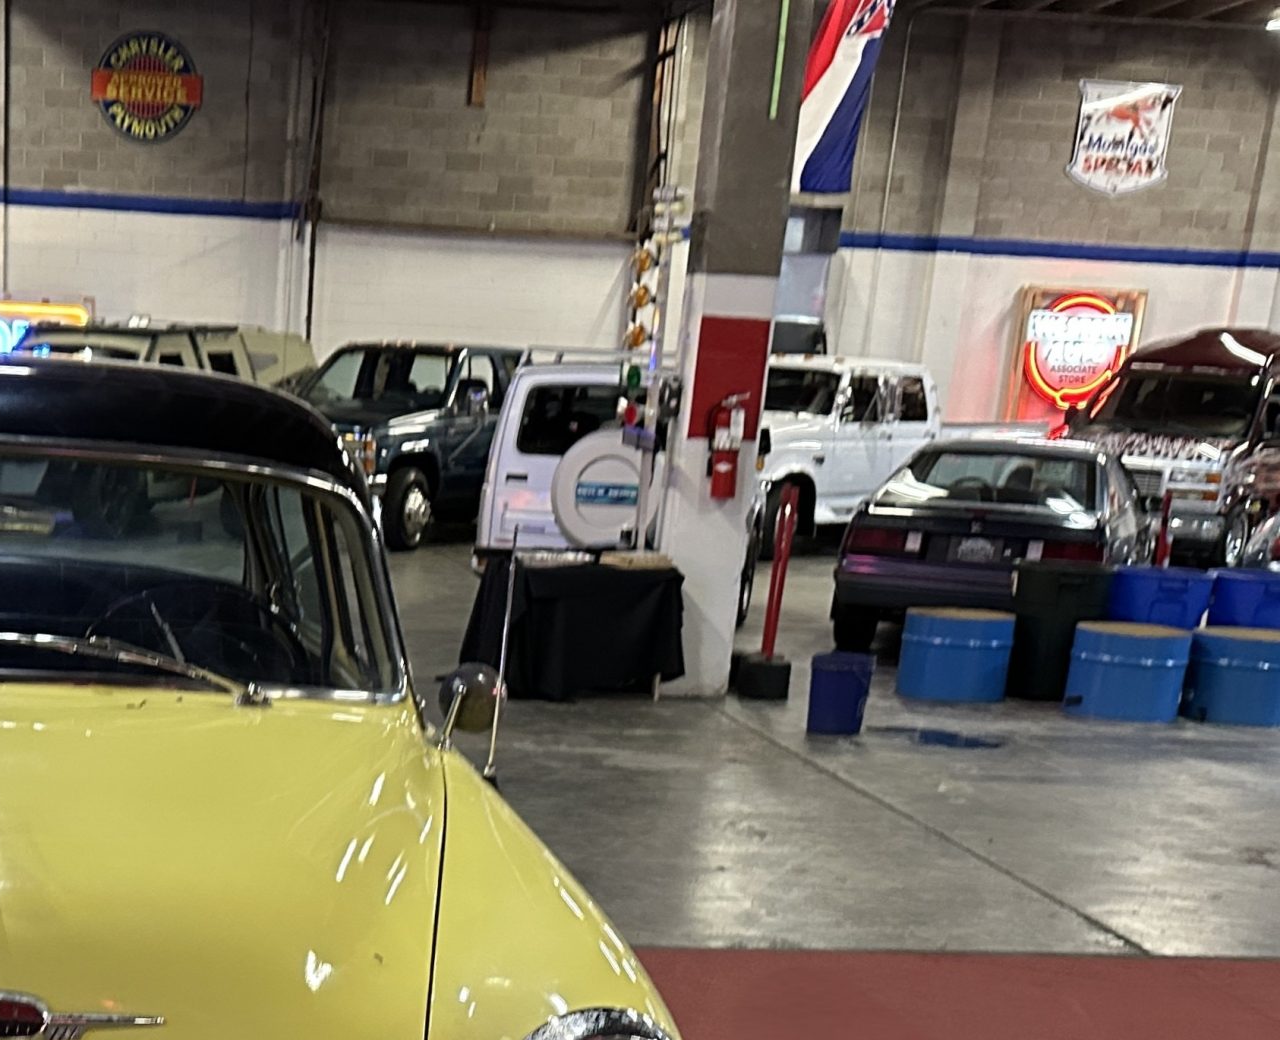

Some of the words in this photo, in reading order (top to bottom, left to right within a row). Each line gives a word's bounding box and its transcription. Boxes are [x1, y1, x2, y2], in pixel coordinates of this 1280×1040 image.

[110, 37, 185, 73] CHRYSLER
[108, 102, 185, 140] PLYMOUTH
[1050, 364, 1099, 374] ASSOCIATE
[1059, 374, 1087, 384] STORE
